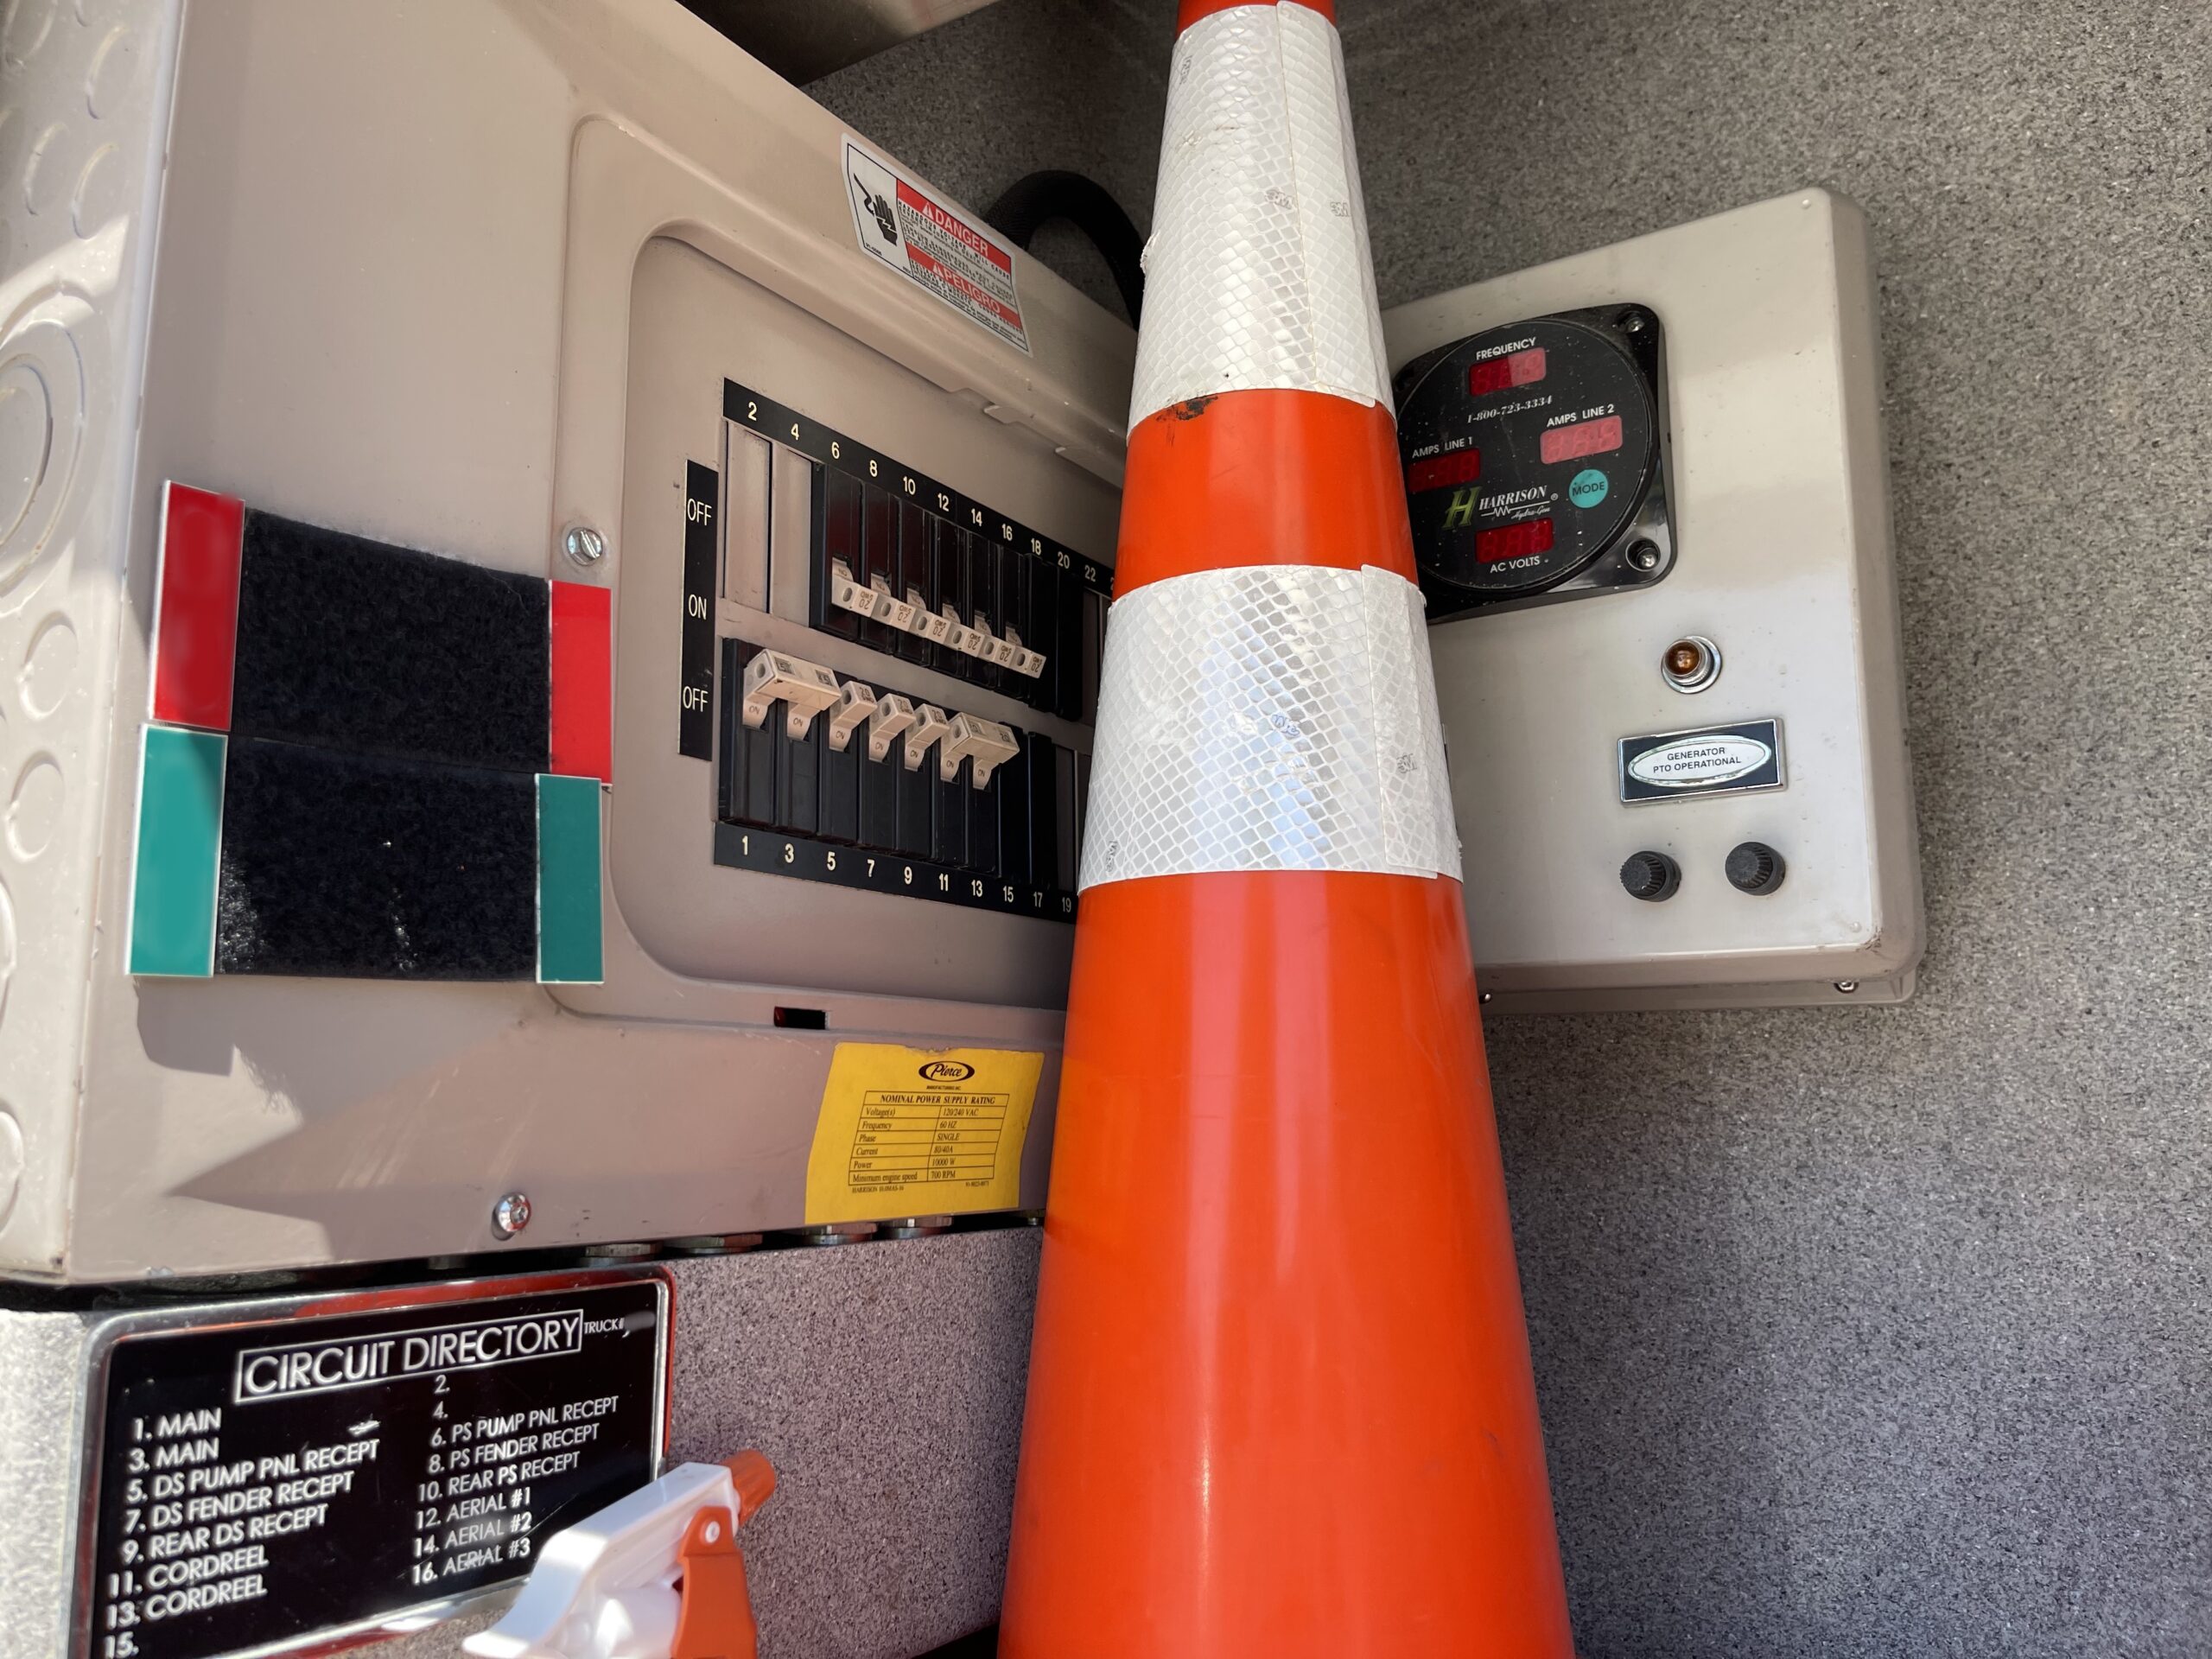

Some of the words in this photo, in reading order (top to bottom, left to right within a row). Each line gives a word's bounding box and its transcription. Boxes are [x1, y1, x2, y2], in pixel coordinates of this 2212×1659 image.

[935, 208, 988, 257] DANGER
[944, 266, 1001, 314] PELIGRO
[1476, 337, 1536, 360] FREQUENCY
[1467, 395, 1553, 423] 1-800-723-3334
[1547, 411, 1577, 428] AMPS
[1582, 406, 1605, 420] LINE
[1606, 404, 1615, 414] 2
[1412, 444, 1440, 459] AMPS
[1444, 439, 1465, 452] LINE
[1468, 436, 1472, 446] 1
[748, 402, 757, 421] 2
[791, 423, 800, 441] 4
[831, 442, 840, 459] 6
[869, 459, 878, 477] 8
[903, 476, 916, 495] 10
[938, 493, 950, 512] 12
[971, 508, 982, 526] 14
[1001, 523, 1013, 541] 16
[1031, 538, 1041, 556] 18
[1057, 552, 1070, 569] 20
[1084, 564, 1096, 582] 22
[1572, 480, 1605, 496] MODE
[687, 498, 712, 526] OFF
[1442, 486, 1482, 530] H
[1478, 485, 1548, 511] HARRISON
[1490, 562, 1506, 574] AC
[1509, 556, 1541, 570] VOLTS
[688, 594, 707, 620] ON
[859, 599, 870, 610] 20
[898, 612, 908, 623] 20
[933, 626, 944, 637] 20
[968, 640, 978, 651] 20
[1000, 652, 1010, 662] 20
[1031, 663, 1040, 673] 20
[683, 685, 709, 712] OFF
[748, 705, 760, 715] ON
[792, 717, 804, 728] ON
[836, 730, 846, 740] ON
[874, 741, 884, 751] ON
[910, 750, 919, 759] ON
[945, 760, 954, 768] ON
[1653, 763, 1672, 773] PTO
[1674, 756, 1742, 772] OPERATIONAL
[1667, 747, 1726, 760] GENERATOR
[977, 768, 985, 778] ON
[742, 835, 749, 855] 1
[785, 843, 794, 862] 3
[827, 851, 836, 870] 5
[867, 859, 875, 877] 7
[904, 867, 912, 885] 9
[938, 874, 950, 892] 11
[971, 880, 983, 897] 13
[1003, 885, 1014, 903] 15
[1033, 891, 1042, 907] 17
[1061, 896, 1071, 912] 19
[930, 1063, 963, 1080] Pierce
[880, 1094, 914, 1103] NOMINAL
[944, 1096, 969, 1104] SUPPLY
[866, 1107, 896, 1118] Voltage(s)
[943, 1108, 964, 1116] 120/240
[965, 1108, 979, 1116] VAC
[858, 1134, 876, 1142] Phase
[937, 1133, 961, 1141] SINGLE
[861, 1121, 893, 1131] Frequency
[950, 1157, 956, 1166] W
[852, 1173, 881, 1183] Minimum
[882, 1173, 900, 1184] engine
[902, 1172, 918, 1184] speed
[931, 1171, 942, 1179] 700
[943, 1170, 956, 1179] RPM
[245, 1341, 396, 1395] CIRCUIT
[404, 1317, 580, 1371] DIRECTORY
[435, 1375, 450, 1394] 2.
[430, 1427, 447, 1446] 6.
[452, 1421, 473, 1443] PS
[476, 1413, 525, 1438] PUMP
[529, 1408, 559, 1427] PNL
[563, 1395, 620, 1421] RECEPT
[433, 1401, 448, 1419] 4.
[133, 1417, 153, 1440] 1.
[157, 1407, 222, 1438] MAIN
[129, 1447, 151, 1472] 3.
[156, 1437, 220, 1468] MAIN
[429, 1454, 445, 1474] 8.
[449, 1448, 470, 1469] PS
[474, 1434, 538, 1464] FENDER
[542, 1423, 601, 1449] RECEPT
[127, 1478, 149, 1503] 5.
[154, 1471, 186, 1498] DS
[189, 1460, 256, 1493] PUMP
[259, 1453, 300, 1480] PNL
[303, 1439, 380, 1471] RECEPT
[418, 1481, 443, 1502] 10.
[448, 1469, 494, 1496] REAR
[498, 1464, 518, 1485] PS
[521, 1451, 581, 1480] RECEPT
[125, 1509, 147, 1534] 7.
[151, 1502, 183, 1529] DS
[187, 1486, 272, 1522] FENDER
[276, 1470, 354, 1504] RECEPT
[417, 1508, 442, 1530] 12.
[446, 1493, 506, 1522] AERIAL
[511, 1487, 531, 1508] #1
[121, 1539, 144, 1565] 9.
[149, 1527, 211, 1560] REAR
[213, 1521, 245, 1548] DS
[248, 1503, 329, 1539] RECEPT
[415, 1535, 440, 1558] 14.
[444, 1519, 505, 1548] AERIAL
[510, 1511, 532, 1533] #2
[109, 1570, 143, 1599] 11.
[146, 1545, 270, 1589] CORDREEL
[412, 1561, 438, 1585] 16.
[442, 1544, 504, 1576] AERIAL
[509, 1537, 531, 1559] #3
[106, 1601, 141, 1630] 13.
[144, 1573, 268, 1620] CORDREEL
[105, 1631, 139, 1659] 15.
